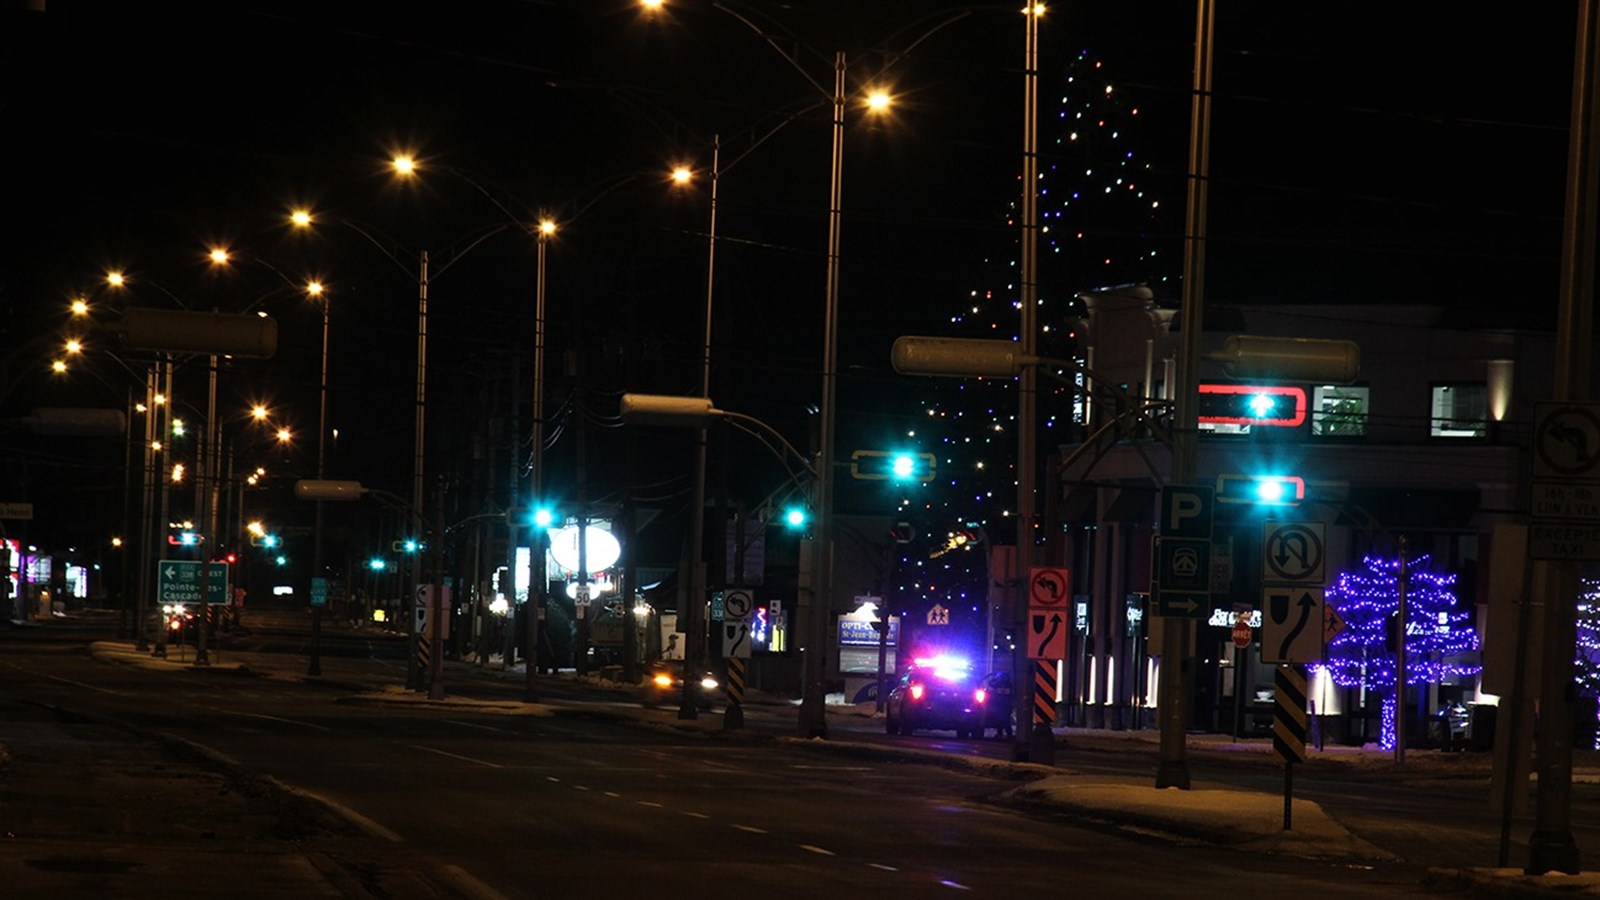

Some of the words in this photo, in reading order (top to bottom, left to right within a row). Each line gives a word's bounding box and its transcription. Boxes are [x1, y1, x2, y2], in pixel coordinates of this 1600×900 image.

[1170, 492, 1203, 530] P
[1537, 501, 1561, 514] LUN
[1552, 543, 1584, 556] TAXI
[577, 592, 590, 604] 50
